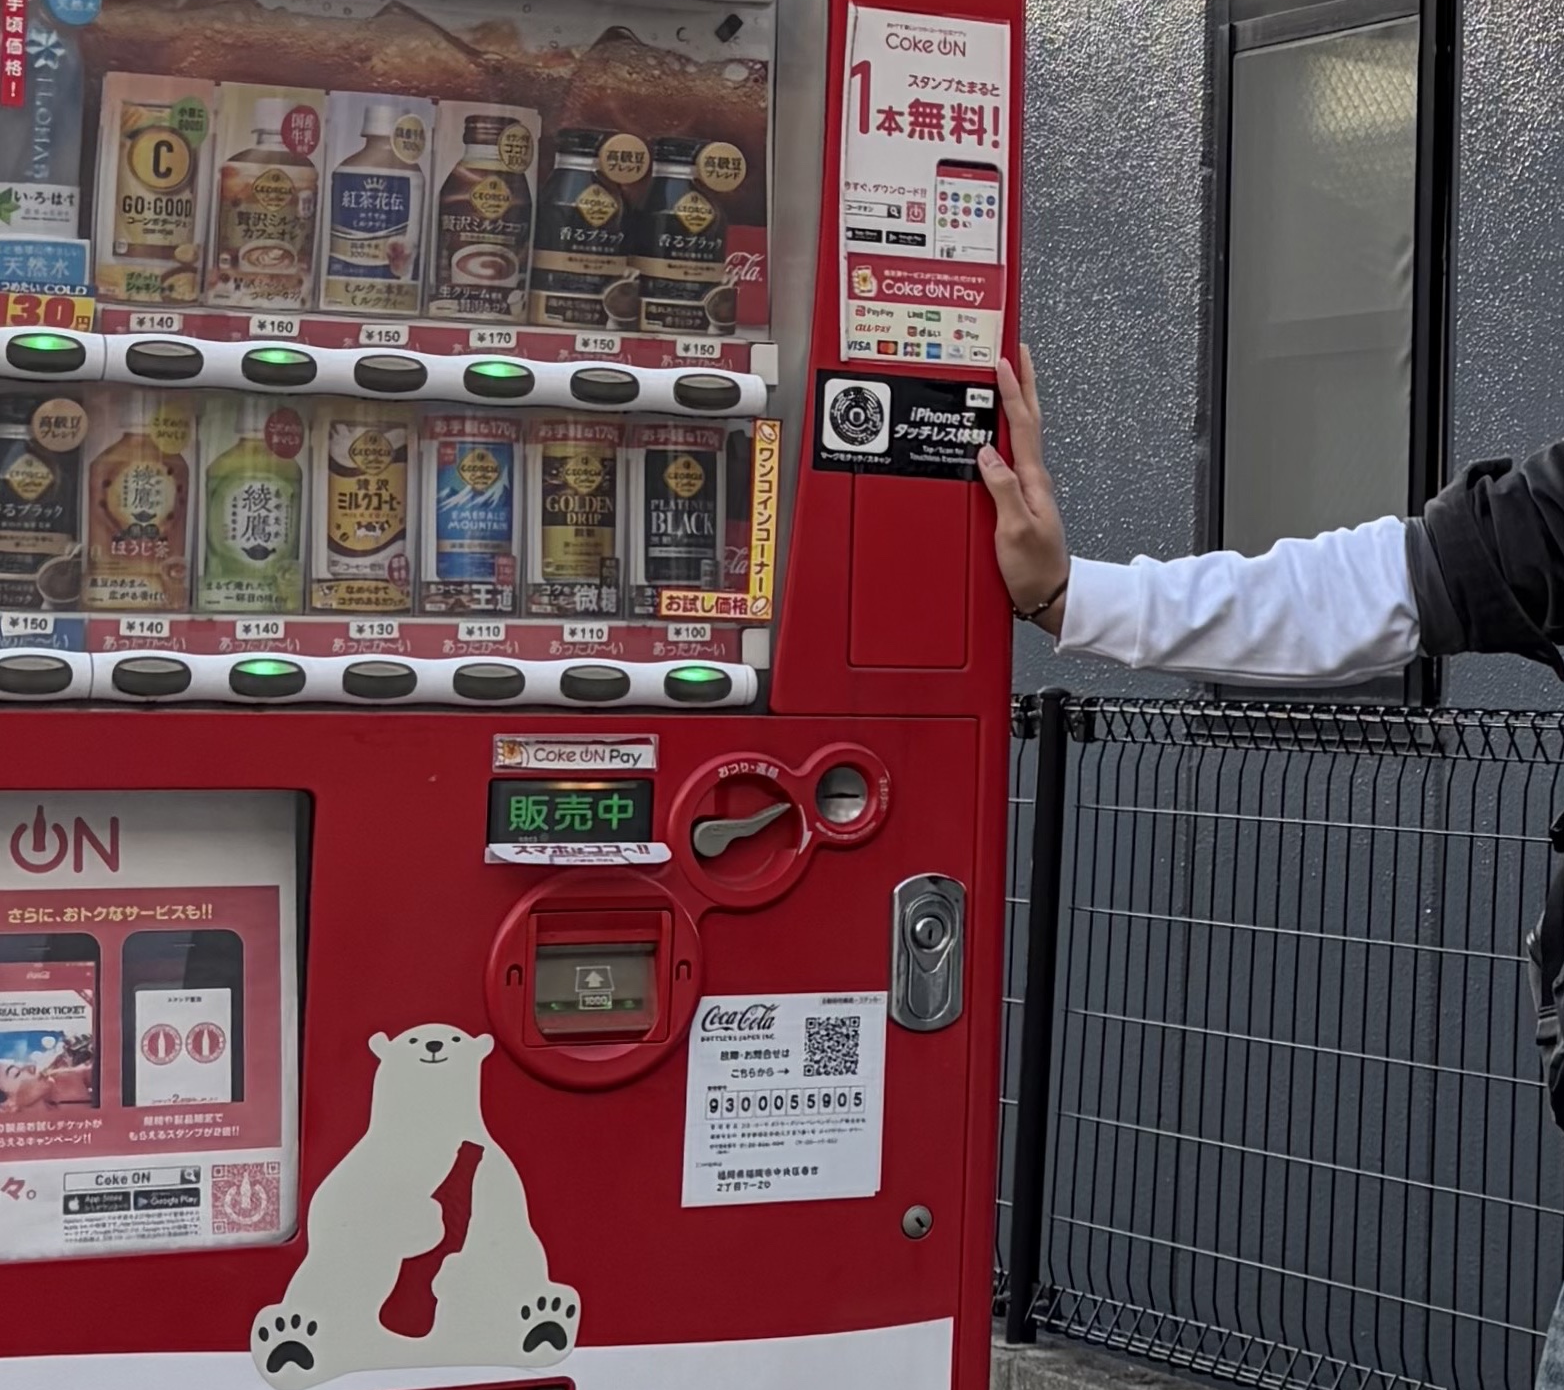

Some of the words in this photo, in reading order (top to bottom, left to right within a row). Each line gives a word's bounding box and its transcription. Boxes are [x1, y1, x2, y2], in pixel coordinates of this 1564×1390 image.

[885, 33, 934, 54] Coke
[938, 37, 967, 57] ON
[907, 74, 1001, 98] スタンプたまると
[850, 59, 1001, 149] 1本無料!
[152, 139, 174, 180] C
[606, 149, 645, 164] 高級豆
[703, 156, 743, 172] 高級豆
[608, 163, 643, 174] ブレンド
[705, 170, 741, 181] ブレンド
[122, 195, 193, 218] GO:GOOD
[341, 190, 404, 211] 紅茶花伝
[559, 226, 625, 243] 香るブラック
[658, 233, 723, 250] 香るブラック
[1, 282, 40, 293] つめたい
[43, 283, 88, 296] COLD
[882, 279, 924, 297] Coke
[926, 281, 951, 300] ON
[953, 285, 985, 306] Pay
[136, 316, 174, 330] ¥140
[257, 319, 295, 334] ¥160
[365, 329, 401, 342] ¥150
[477, 332, 512, 344] ¥170
[581, 338, 615, 351] ¥150
[682, 343, 716, 356] ¥150
[846, 340, 872, 352] VISA
[39, 415, 81, 430] 高級豆
[910, 406, 976, 427] iPhoneで
[40, 428, 79, 439] ブレンド
[337, 492, 402, 511] ミルクコーヒー
[545, 495, 614, 513] GOLDEN
[241, 483, 273, 543] 綾鷹
[451, 510, 508, 521] EMERALD
[566, 512, 602, 525] DRIP
[753, 447, 776, 593] ワンコインコーナー
[650, 511, 714, 536] BLACK
[111, 540, 170, 558] ほうじ茶
[665, 593, 748, 616] お試し価格
[9, 616, 48, 631] ¥150
[126, 621, 164, 634] ¥140
[242, 622, 279, 635] ¥140
[355, 623, 395, 636] ¥130
[465, 625, 501, 638] ¥110
[568, 627, 605, 640] ¥110
[673, 627, 707, 639] ¥100
[533, 747, 577, 763] Coke
[579, 746, 606, 763] ON
[608, 748, 643, 767] Pay
[508, 792, 635, 832] 販売中
[7, 903, 213, 924] さらに、おトクなサービスも!!
[95, 1173, 128, 1186] Coke
[131, 1171, 151, 1185] ON
